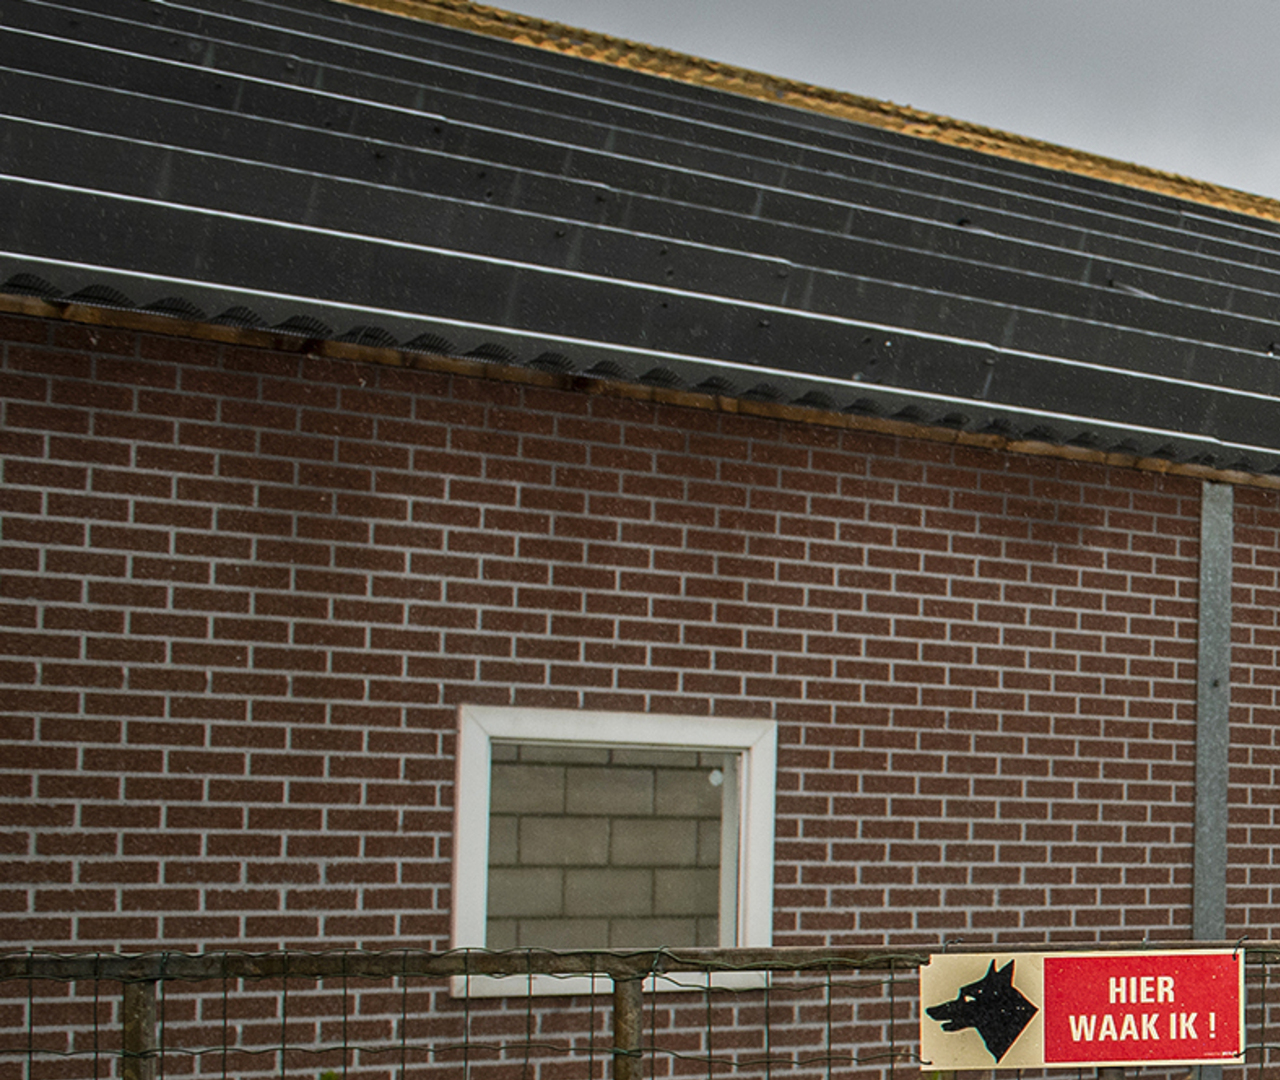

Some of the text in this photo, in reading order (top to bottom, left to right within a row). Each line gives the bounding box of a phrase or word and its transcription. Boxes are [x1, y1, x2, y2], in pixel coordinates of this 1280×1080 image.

[1108, 976, 1175, 1004] HIER
[1069, 1013, 1160, 1042] WAAK
[1169, 1012, 1198, 1040] IK
